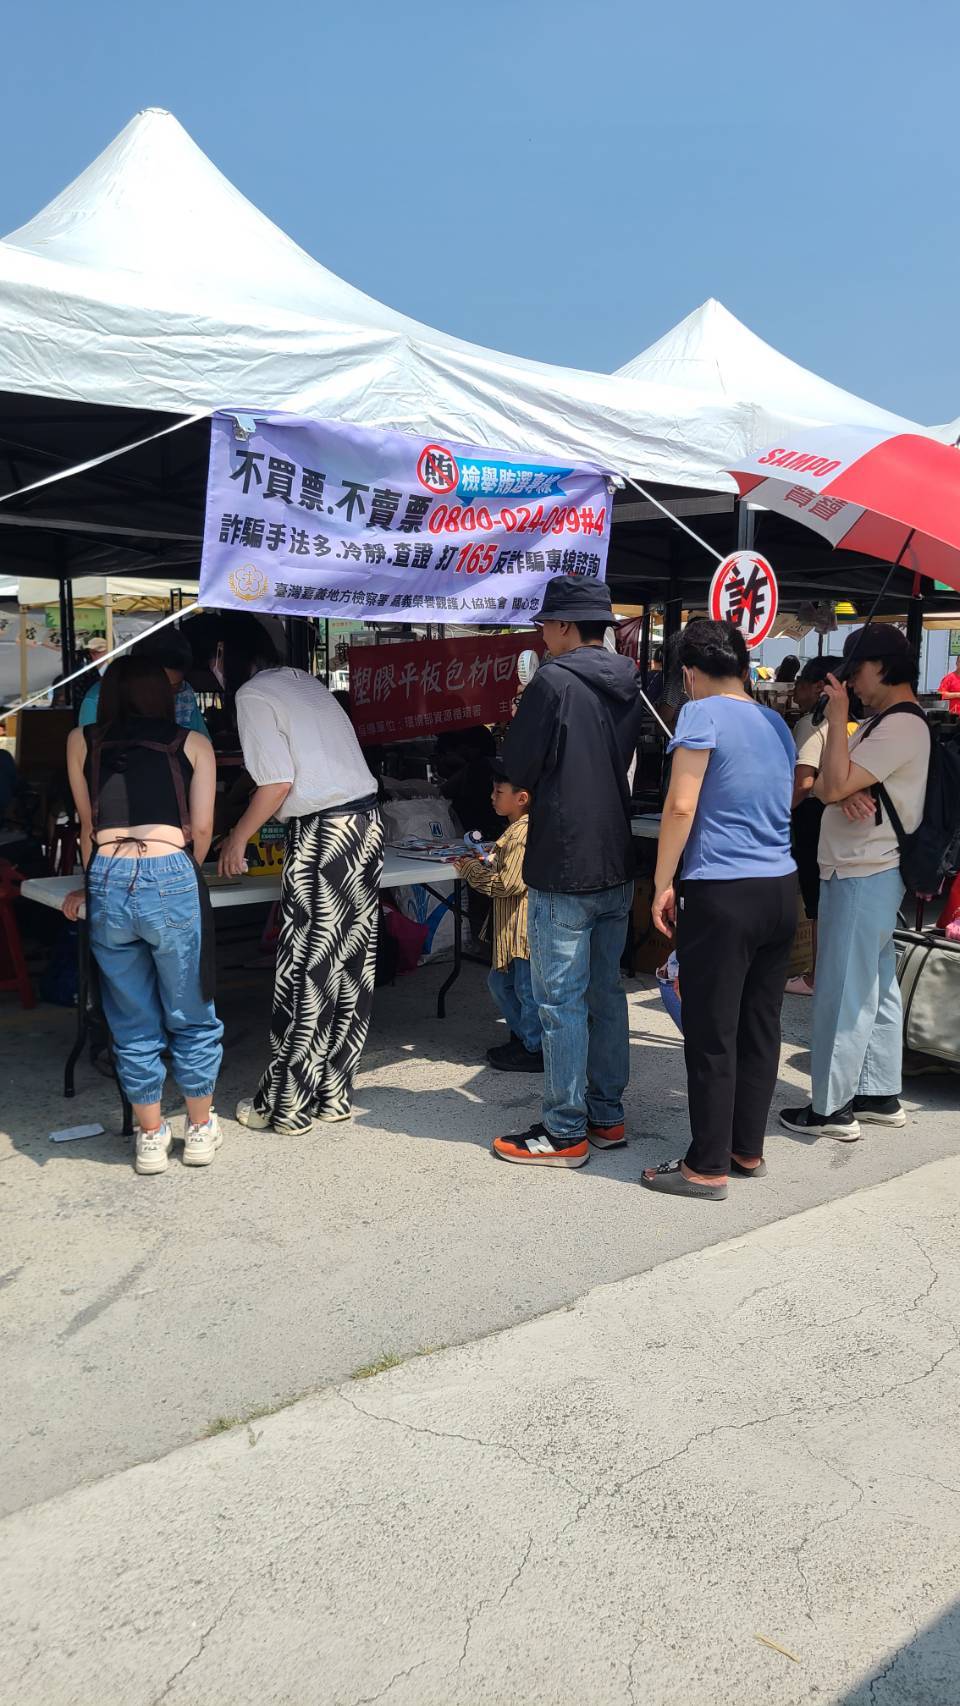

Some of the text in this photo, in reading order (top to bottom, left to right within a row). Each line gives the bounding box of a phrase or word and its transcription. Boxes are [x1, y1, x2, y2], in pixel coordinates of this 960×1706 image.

[758, 448, 842, 477] SAMPO
[461, 464, 561, 495] 檢舉賄選專線
[428, 503, 606, 537] 0800-024-099#4
[725, 563, 768, 634] 詐
